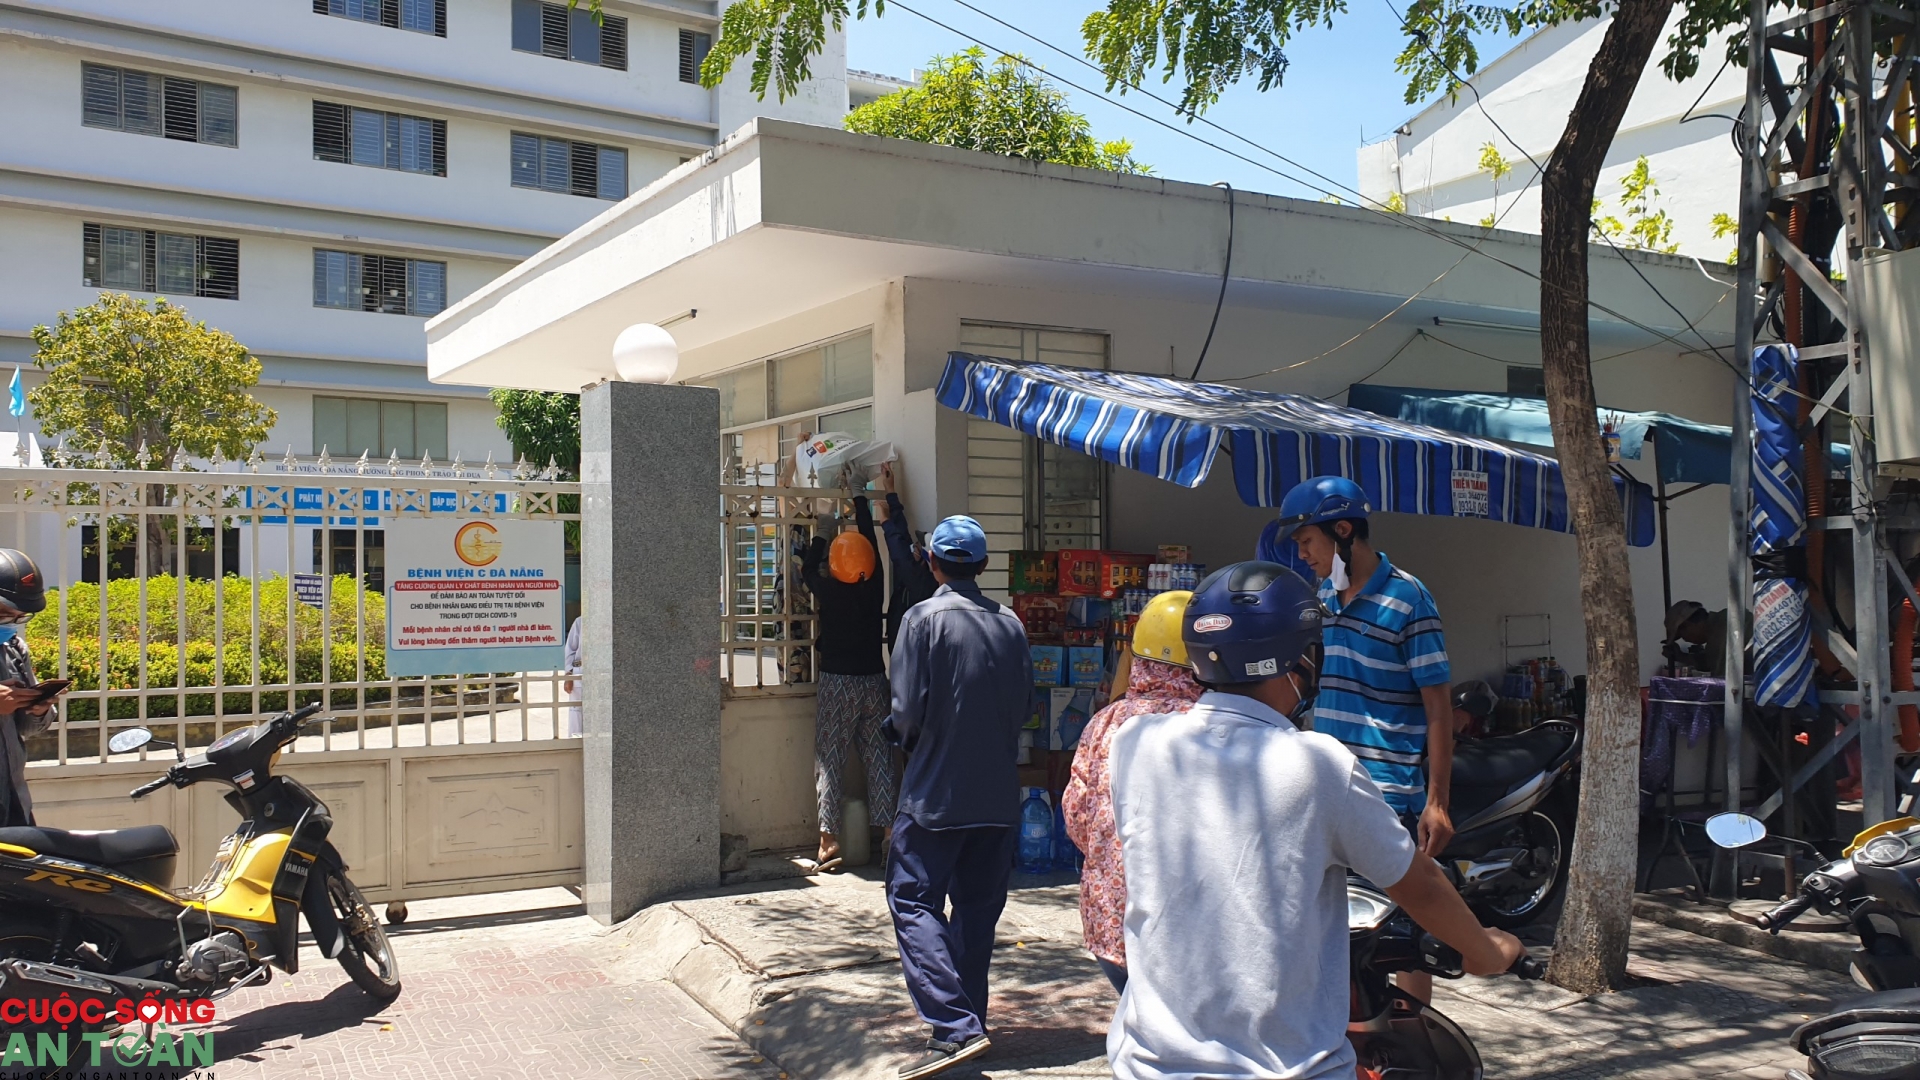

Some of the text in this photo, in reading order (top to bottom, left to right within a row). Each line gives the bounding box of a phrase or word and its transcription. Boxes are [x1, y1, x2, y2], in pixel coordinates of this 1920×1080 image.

[298, 492, 314, 503] PHÁT
[446, 497, 457, 509] DỊC
[408, 566, 544, 579] BỆNH VIỆN C ĐÀ NẴNG
[456, 581, 464, 589] LÝ
[425, 602, 441, 610] BỆNH
[1766, 594, 1797, 621] 3644072
[475, 612, 489, 620] DỊCH
[417, 626, 433, 634] bệnh
[411, 637, 425, 646] lòng
[427, 637, 446, 646] không
[498, 636, 513, 644] bệnh
[525, 635, 540, 643] Bệnh
[285, 862, 308, 877] YAMAHA
